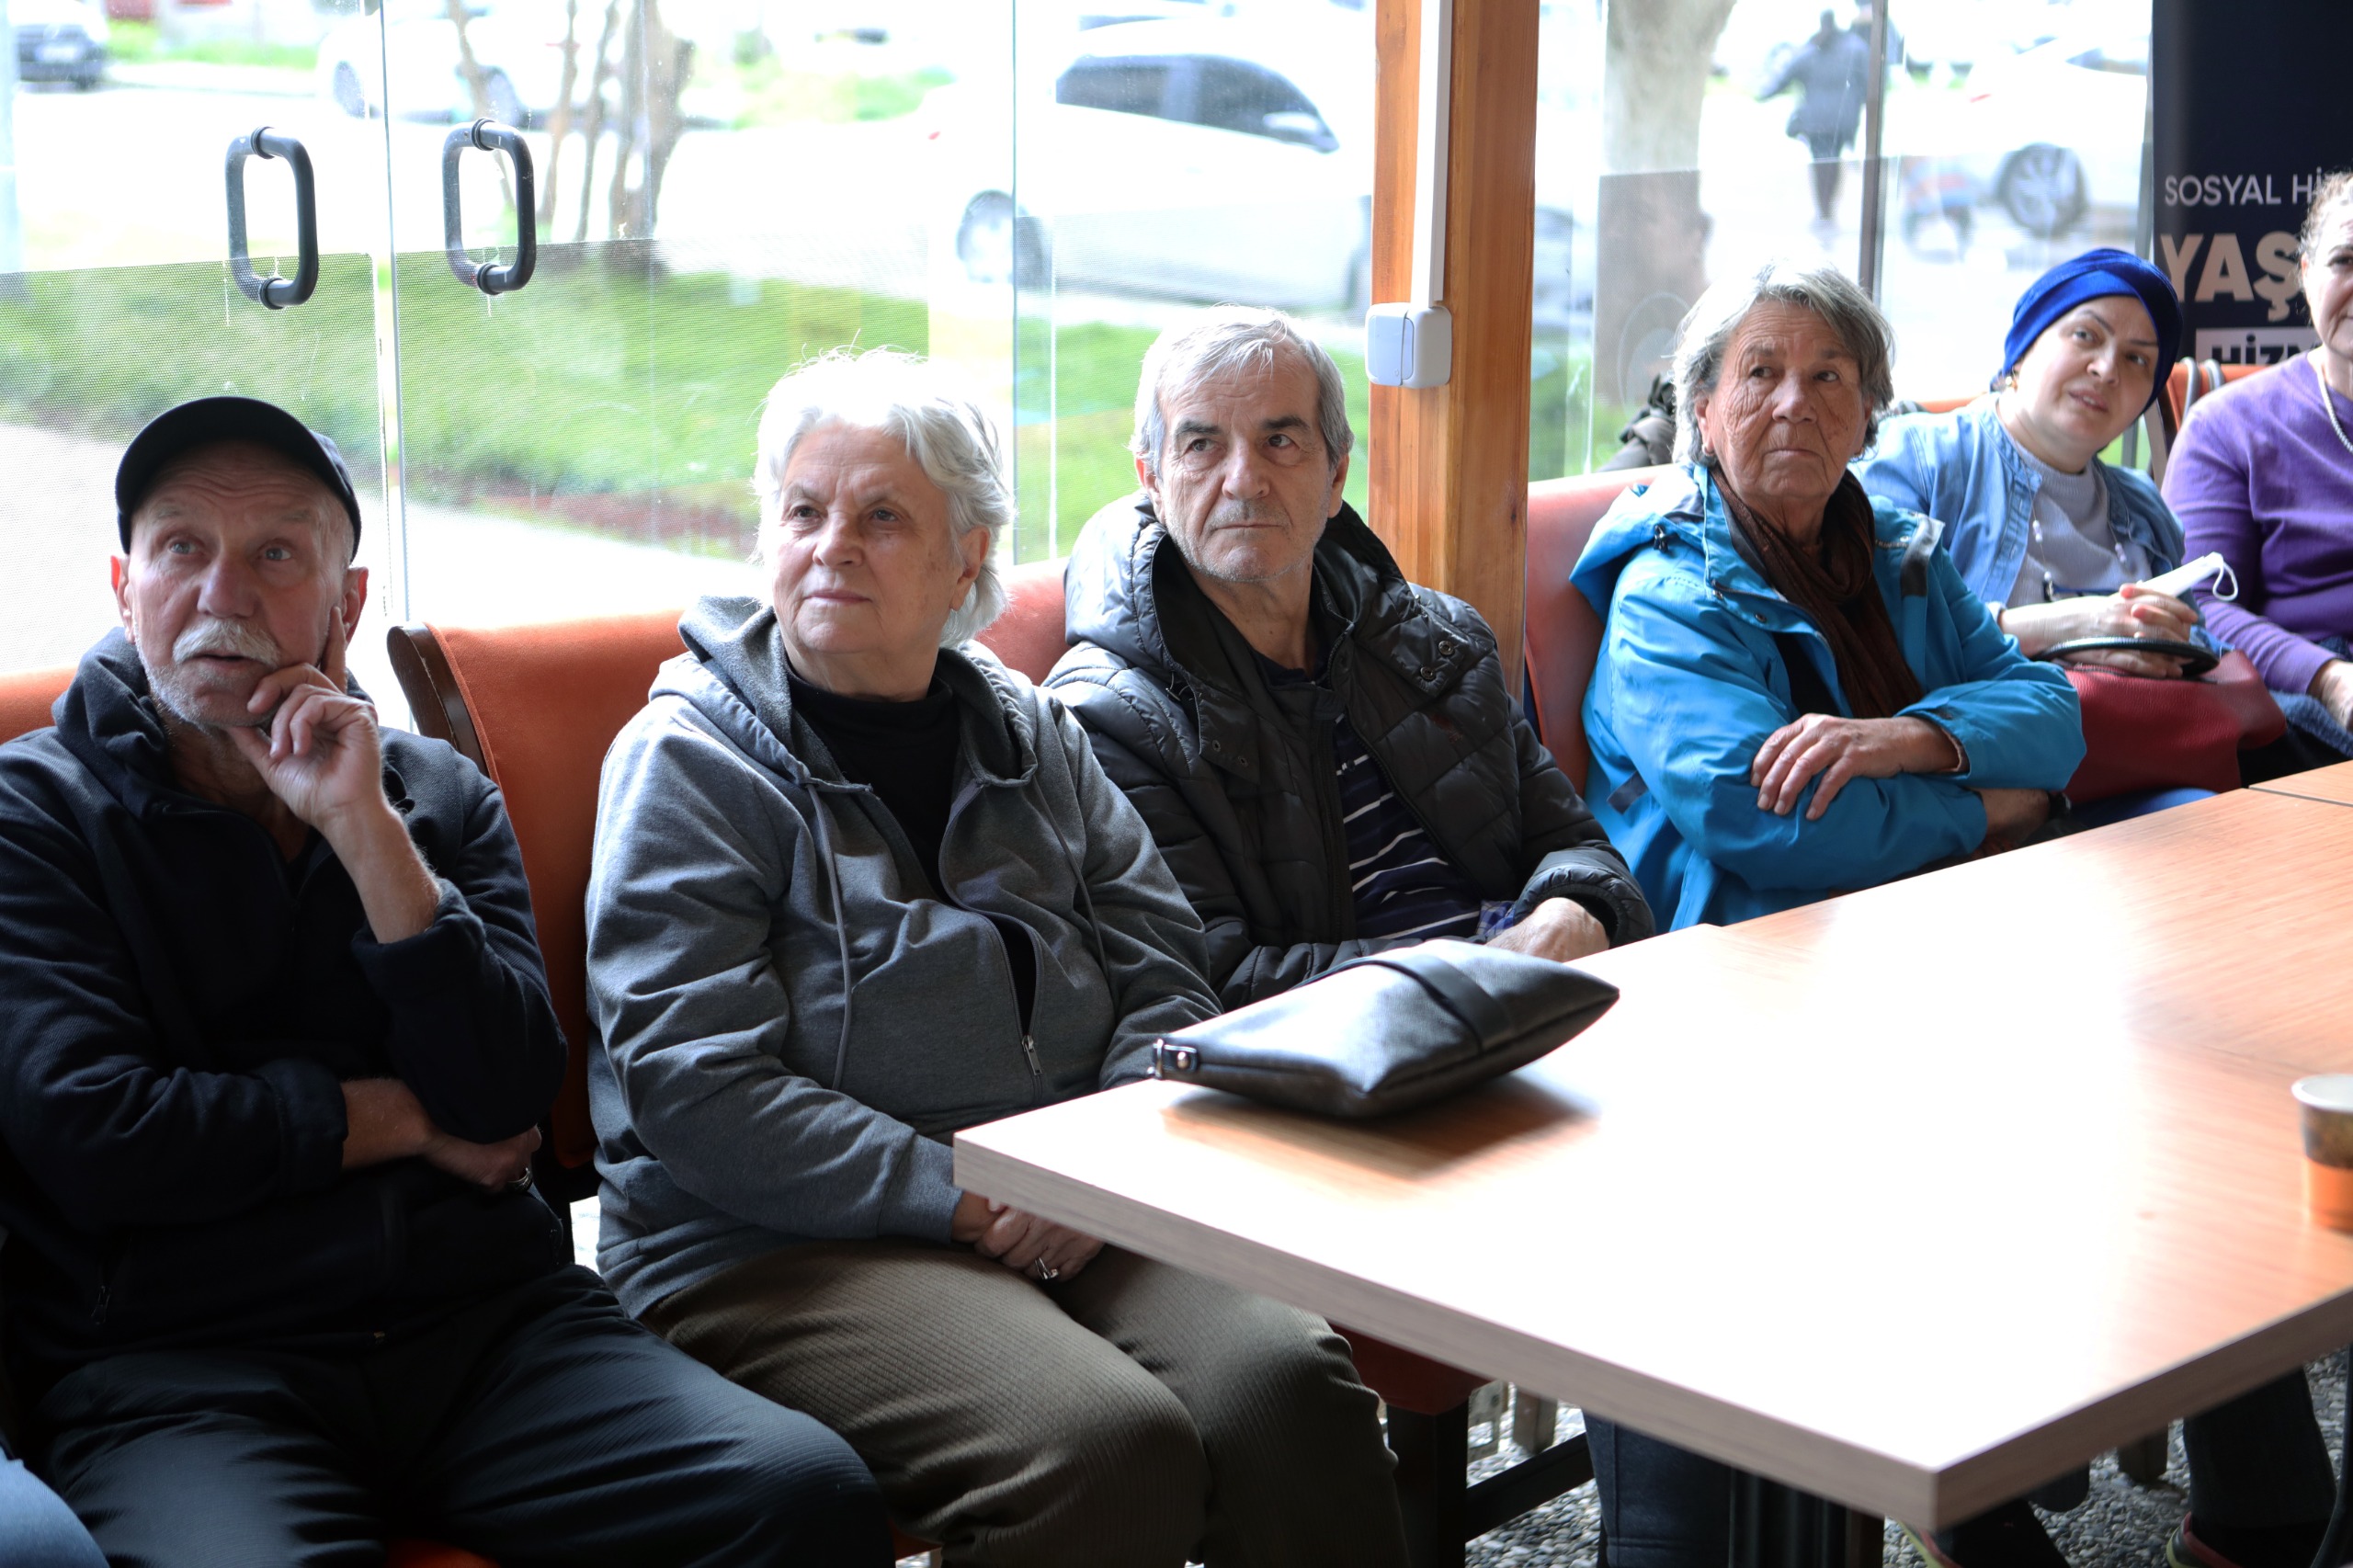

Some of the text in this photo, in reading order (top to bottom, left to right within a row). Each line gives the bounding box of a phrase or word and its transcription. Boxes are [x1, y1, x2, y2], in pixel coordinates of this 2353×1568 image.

[2165, 166, 2333, 207] SOSYAL Hİ
[2160, 231, 2302, 322] YAŞ
